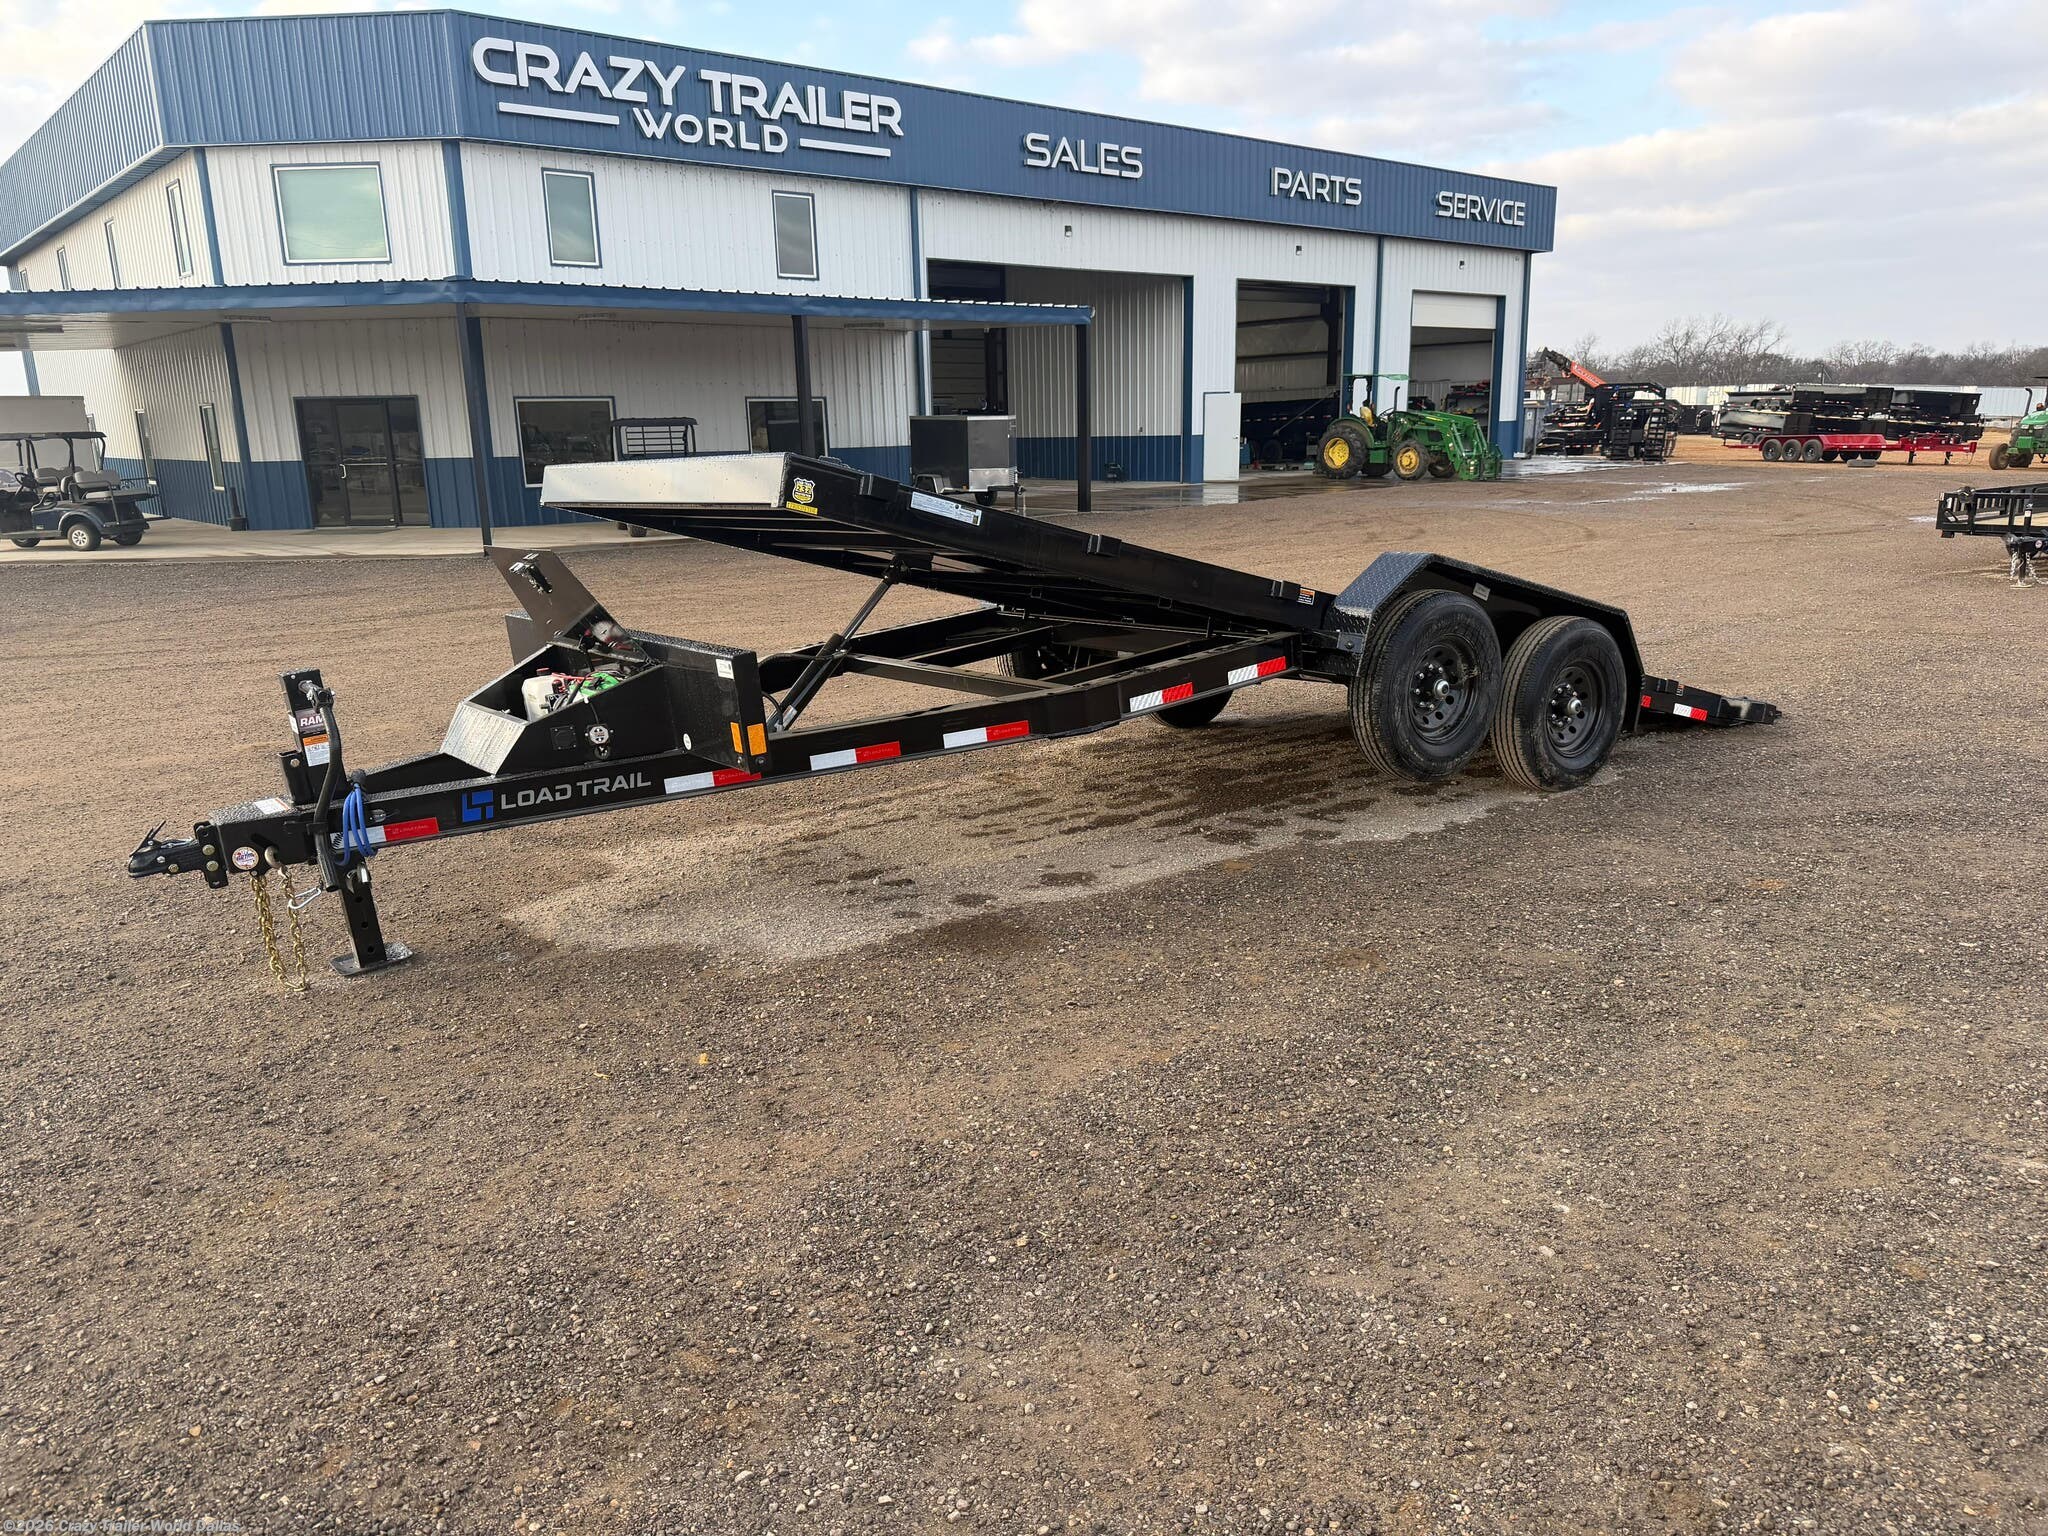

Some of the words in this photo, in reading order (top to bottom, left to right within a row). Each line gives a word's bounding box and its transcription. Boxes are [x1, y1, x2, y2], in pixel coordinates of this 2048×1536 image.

[472, 37, 686, 106] CRAZY
[699, 69, 905, 136] TRAILER
[633, 107, 788, 153] WORLD
[1023, 132, 1144, 180] SALES
[1270, 166, 1363, 206] PARTS
[1436, 190, 1526, 227] SERVICE
[501, 783, 572, 810] LOAD
[576, 771, 652, 796] TRAIL
